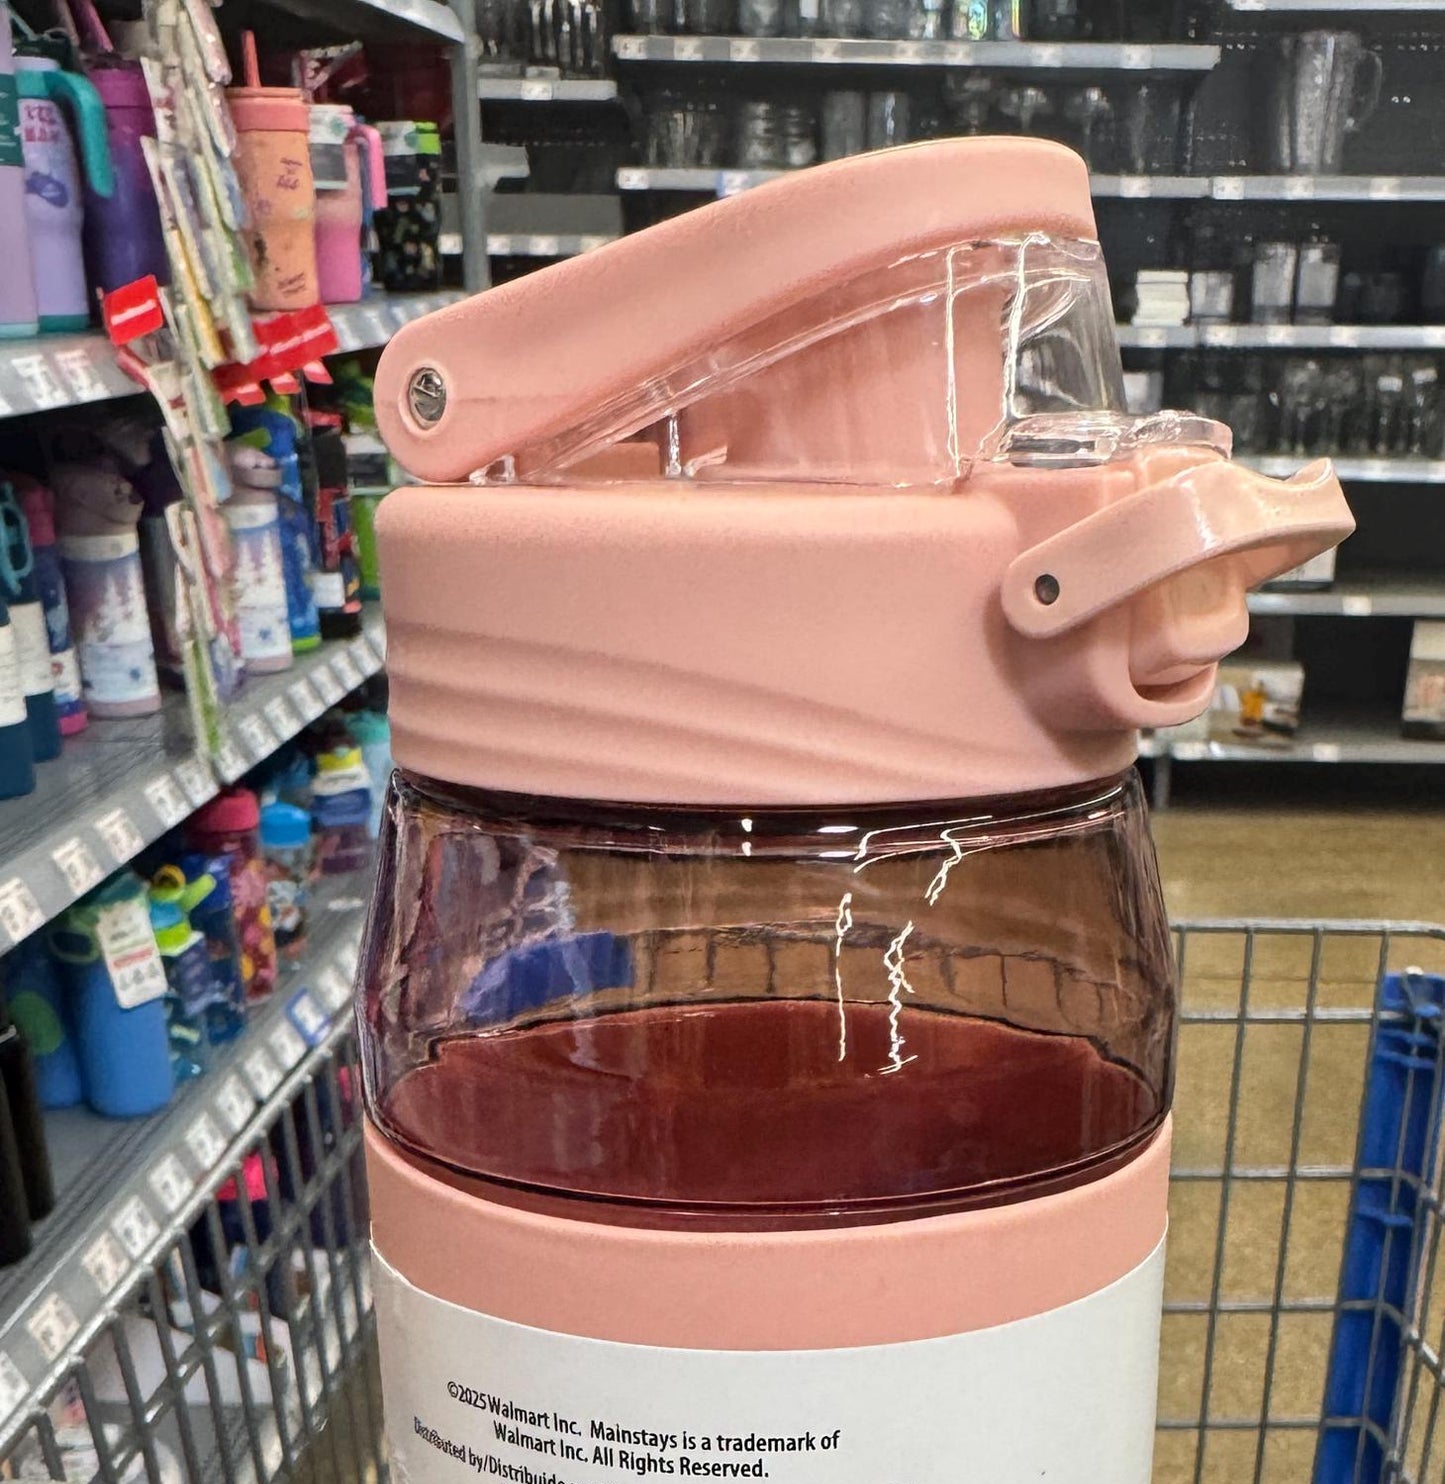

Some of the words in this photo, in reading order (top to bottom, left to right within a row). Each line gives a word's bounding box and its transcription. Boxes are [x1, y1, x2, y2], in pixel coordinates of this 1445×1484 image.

[487, 1394, 550, 1429] Walmart
[553, 1412, 582, 1437] Inc.
[590, 1420, 678, 1452] Mainstays
[682, 1431, 696, 1450] is
[701, 1436, 711, 1451] a
[717, 1432, 816, 1452] trademark
[820, 1430, 841, 1450] of
[493, 1420, 557, 1456] Walmart
[560, 1439, 588, 1463] Inc.
[592, 1446, 613, 1467] All
[618, 1450, 674, 1475] Rights
[679, 1458, 769, 1478] Reserved.
